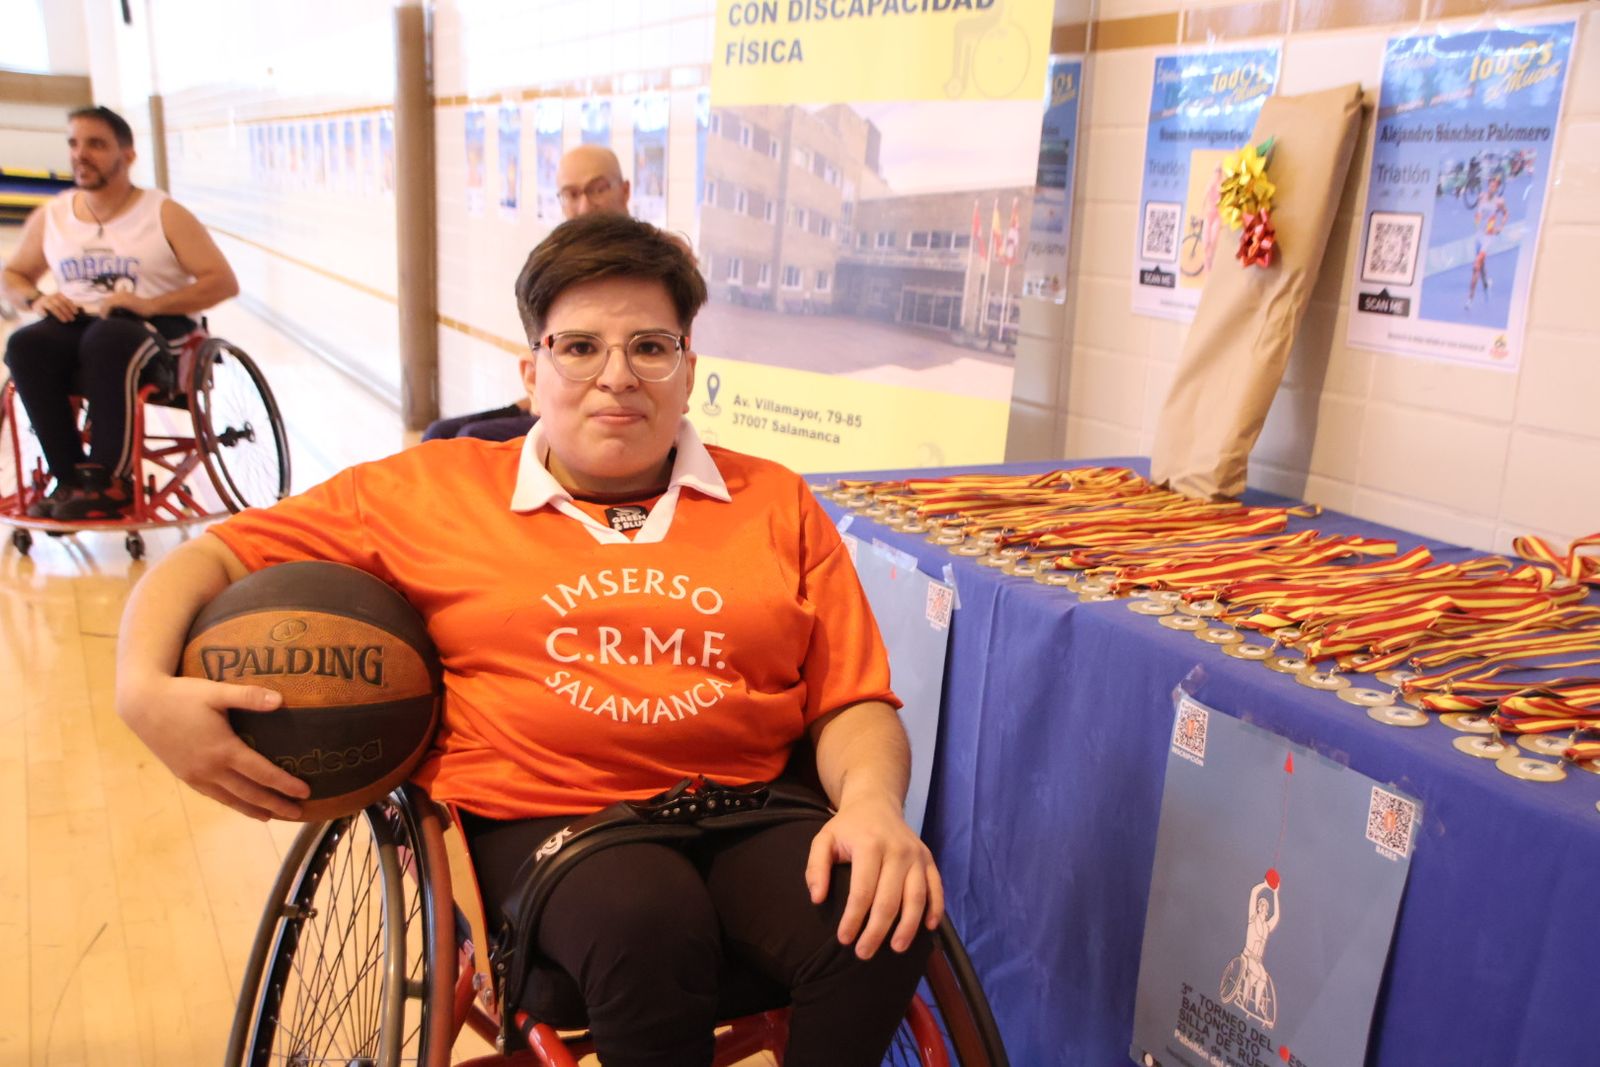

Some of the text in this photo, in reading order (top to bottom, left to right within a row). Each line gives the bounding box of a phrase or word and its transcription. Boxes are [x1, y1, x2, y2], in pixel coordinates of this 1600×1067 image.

[728, 3, 778, 27] CON
[725, 37, 804, 66] FÍSICA
[1380, 121, 1551, 147] Alejandro Sánchez Palomero
[1377, 162, 1431, 185] Triatlón
[60, 254, 140, 286] MAGIC
[1364, 296, 1404, 314] SCAN ME
[733, 394, 863, 428] Av. Villamayor, 79-85
[732, 412, 841, 444] 37007 Salamanca
[611, 514, 647, 523] GREEN
[541, 567, 723, 617] IMSERSO
[545, 626, 726, 670] C.R.M.F.
[544, 670, 733, 724] SALAMANCA
[276, 738, 382, 776] ndesa
[1179, 1008, 1210, 1038] SILLA
[1216, 1034, 1232, 1053] DE
[1182, 997, 1260, 1057] BALONCESTO
[1200, 993, 1247, 1033] TORNEO
[1250, 1028, 1275, 1053] DEL
